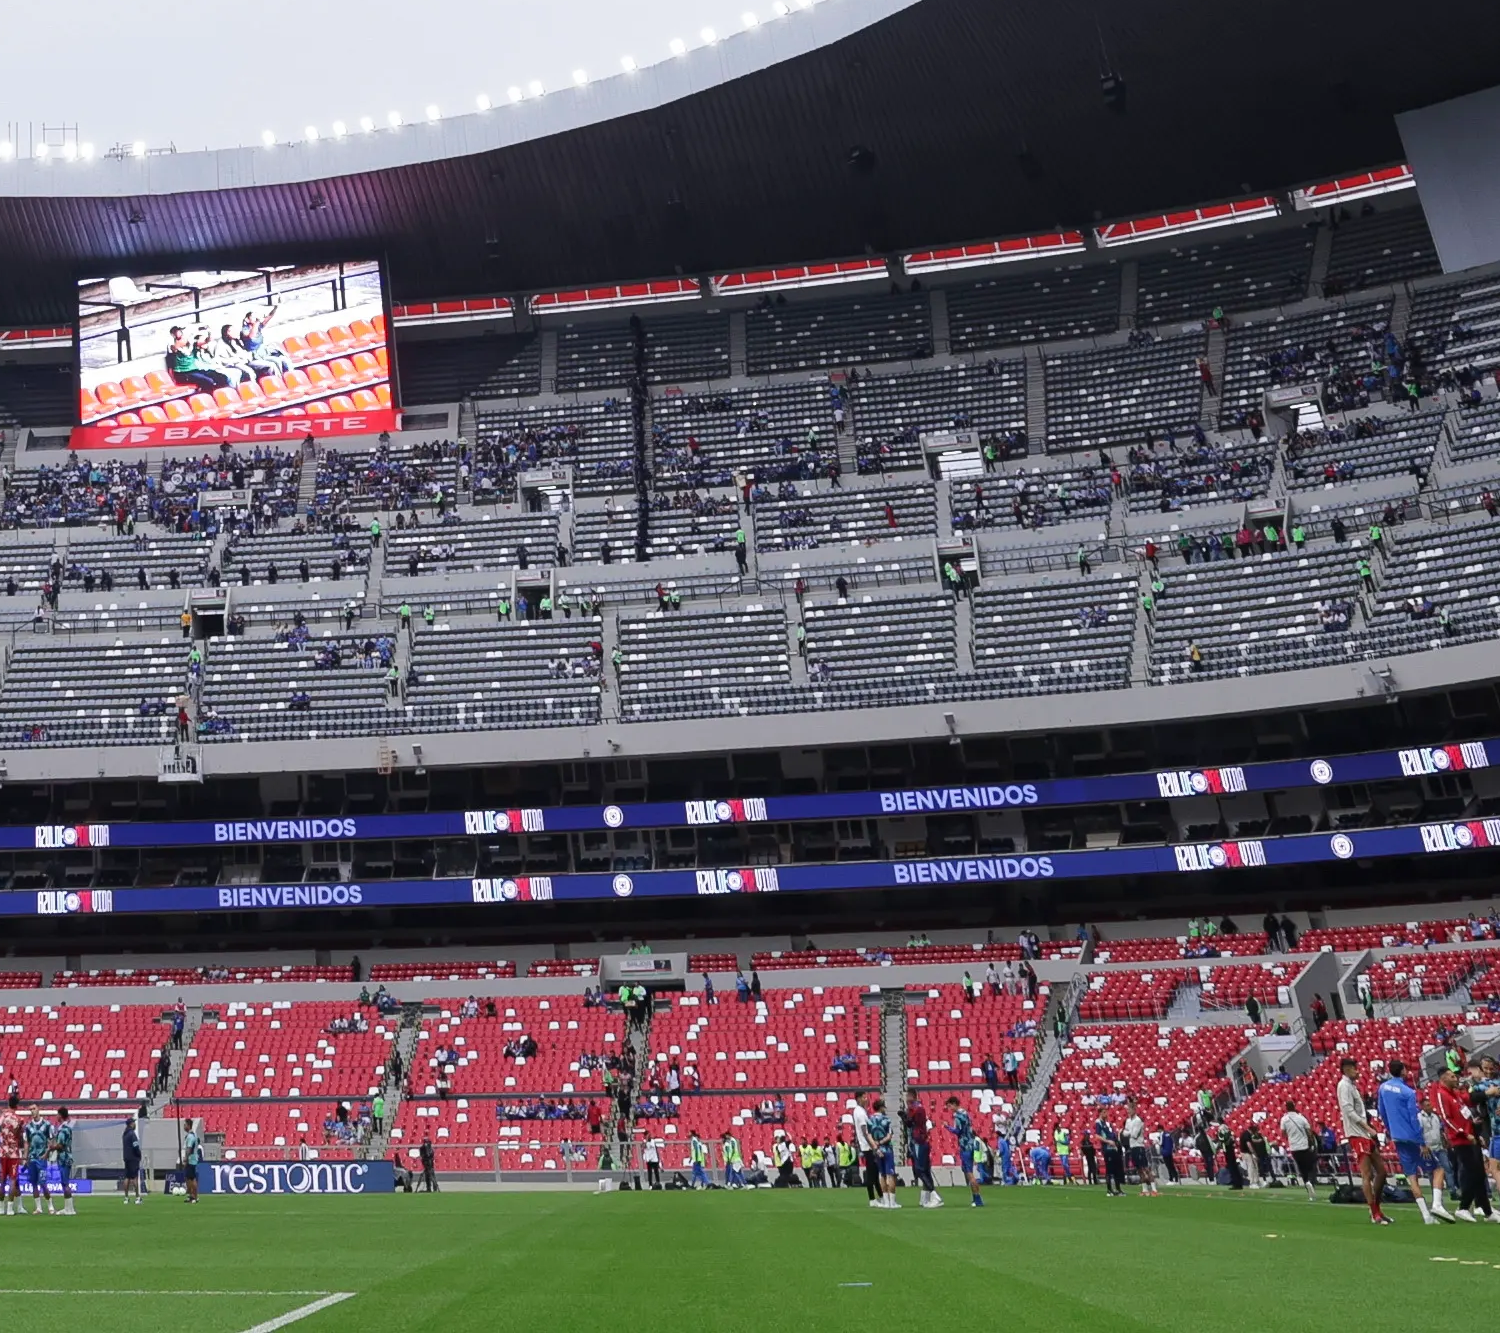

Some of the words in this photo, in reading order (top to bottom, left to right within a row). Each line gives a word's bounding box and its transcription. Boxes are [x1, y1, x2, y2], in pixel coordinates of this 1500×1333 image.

[163, 416, 367, 441] BANORTE
[879, 784, 1038, 812] BIENVENIDOS
[214, 818, 357, 842] BIENVENIDOS
[893, 856, 1054, 884] BIENVENIDOS
[218, 884, 363, 907] BIENVENIDOS
